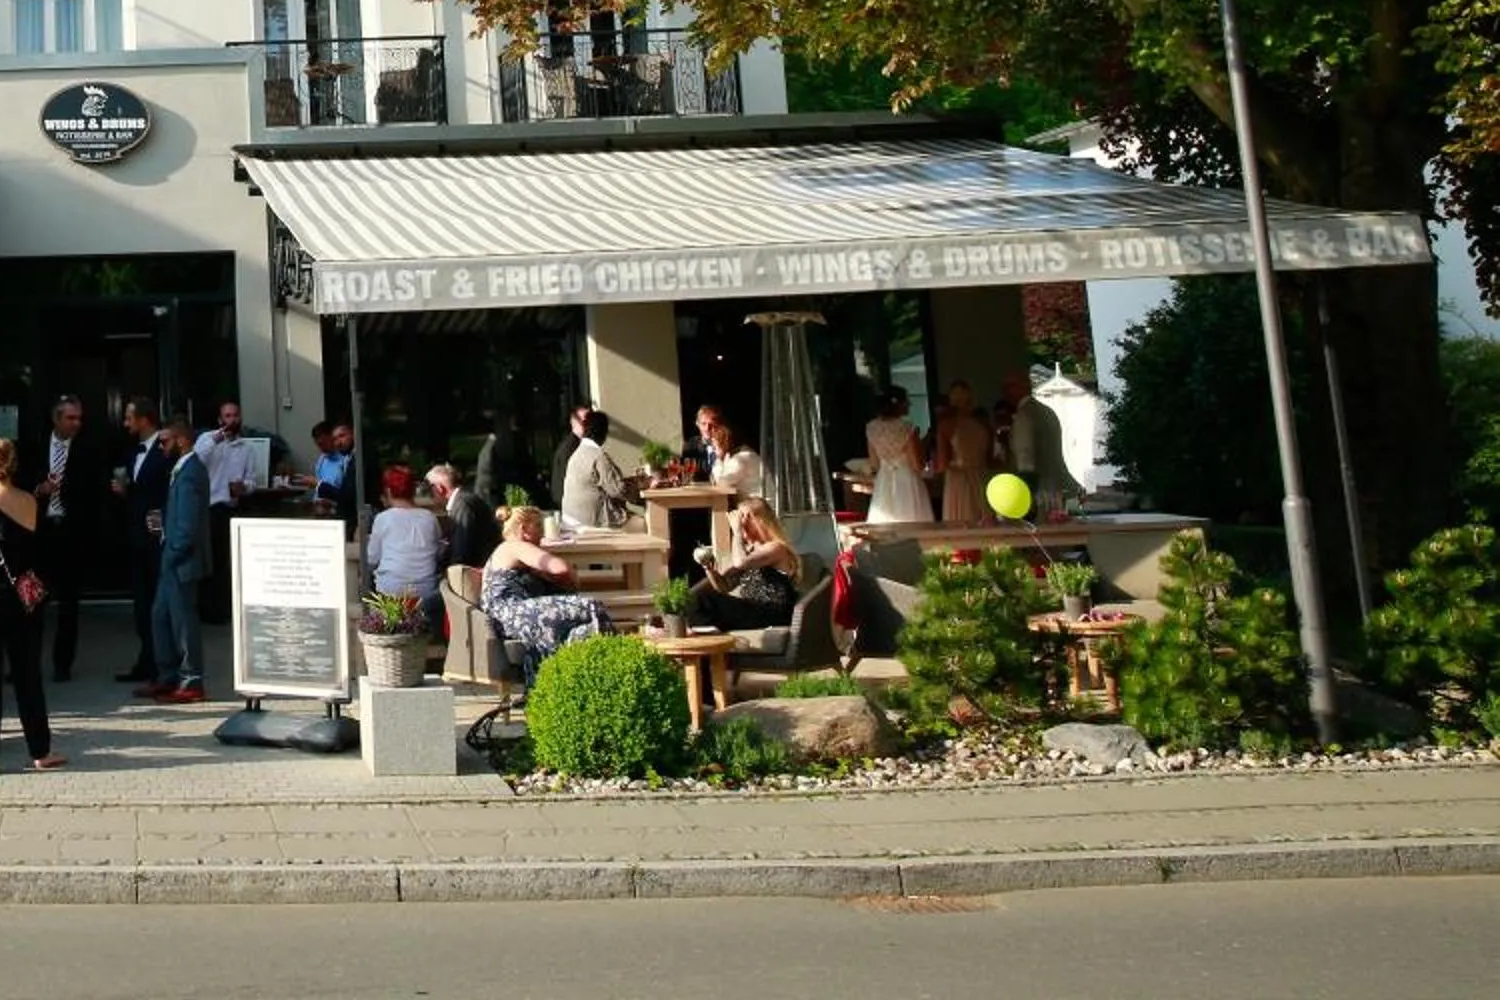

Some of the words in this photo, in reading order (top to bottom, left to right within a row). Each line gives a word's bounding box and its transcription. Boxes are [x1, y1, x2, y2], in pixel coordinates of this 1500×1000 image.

[88, 118, 99, 130] &
[322, 268, 436, 304] ROAST
[450, 268, 476, 299] &
[487, 262, 583, 298] FRIED
[595, 256, 742, 293] CHICKEN
[777, 248, 895, 286] WINGS
[907, 249, 933, 279] &
[942, 242, 1070, 278] DRUMS
[1101, 228, 1300, 270] ROTISSEIE
[1312, 228, 1338, 257] &
[1346, 224, 1425, 257] BAR
